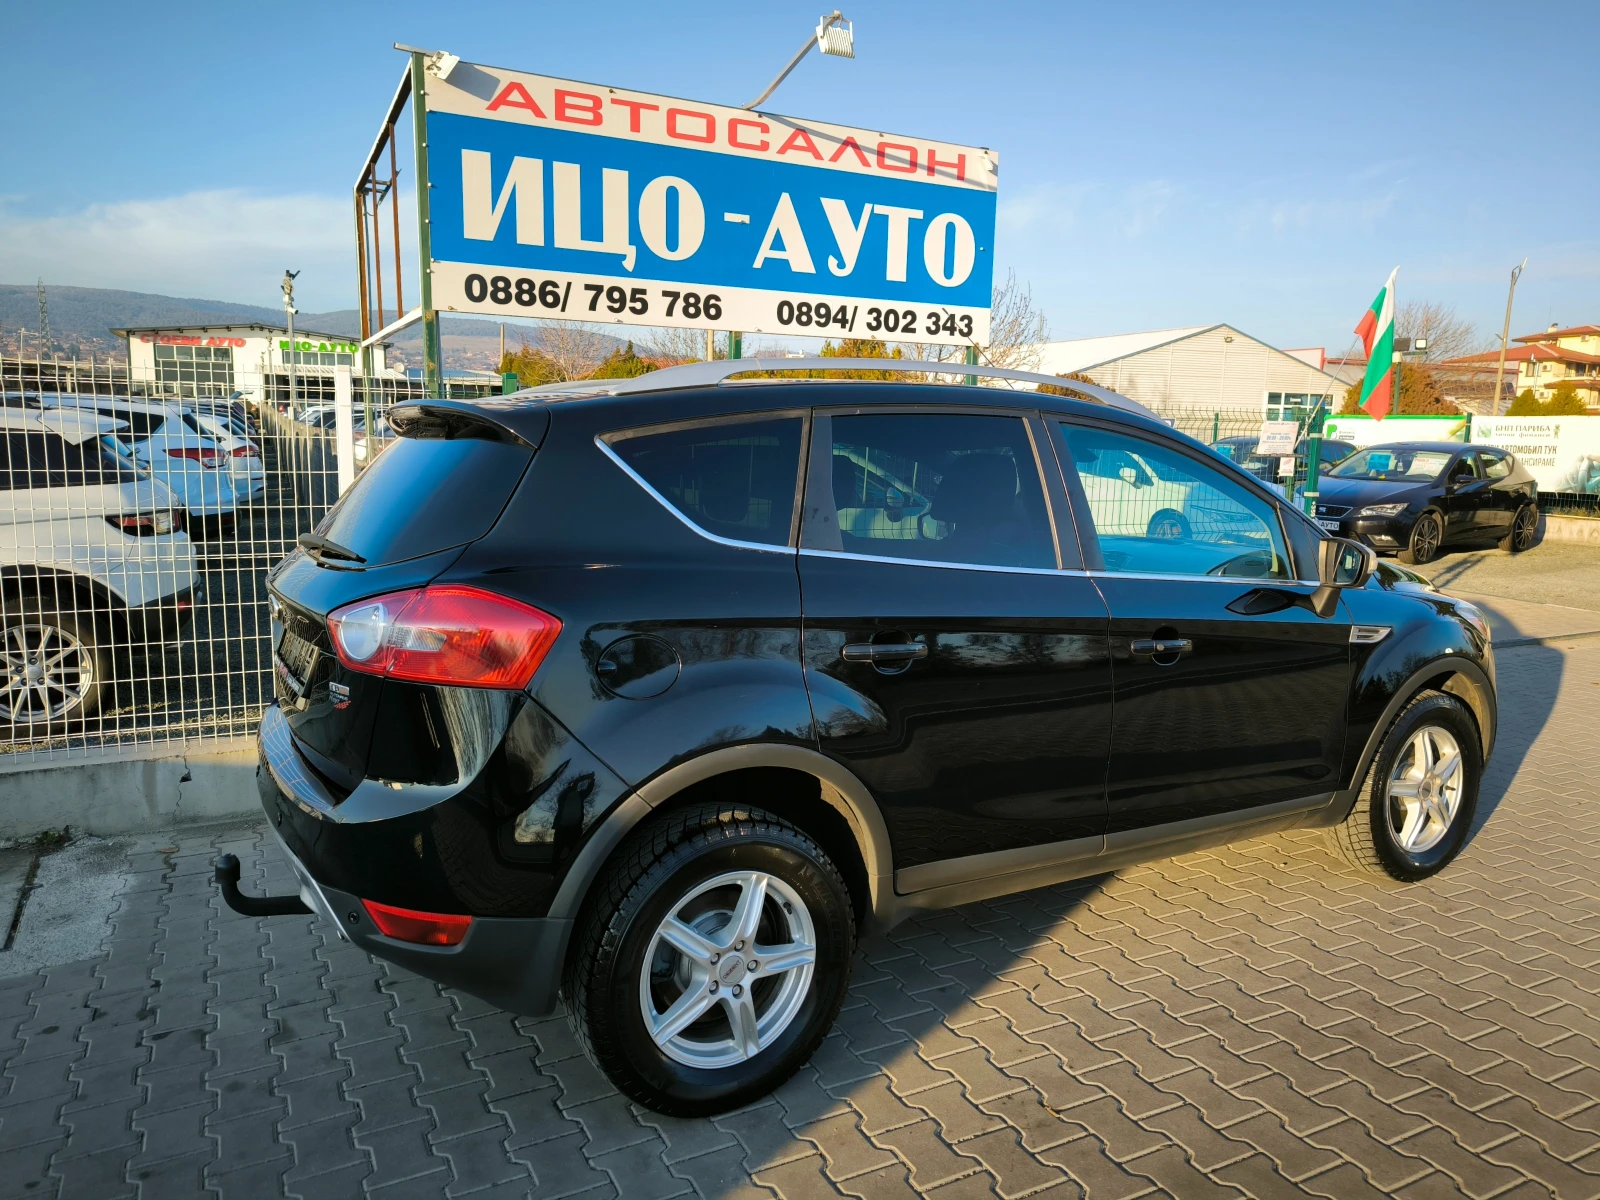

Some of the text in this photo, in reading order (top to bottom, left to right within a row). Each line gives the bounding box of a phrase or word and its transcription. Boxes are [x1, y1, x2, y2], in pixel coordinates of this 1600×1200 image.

[485, 81, 966, 181] АВТОСАЛОН
[464, 273, 722, 321] 0886/ 795 786
[776, 299, 974, 338] 0894/ 302 343
[206, 336, 246, 348] АУТО
[1544, 445, 1558, 455] ТУК
